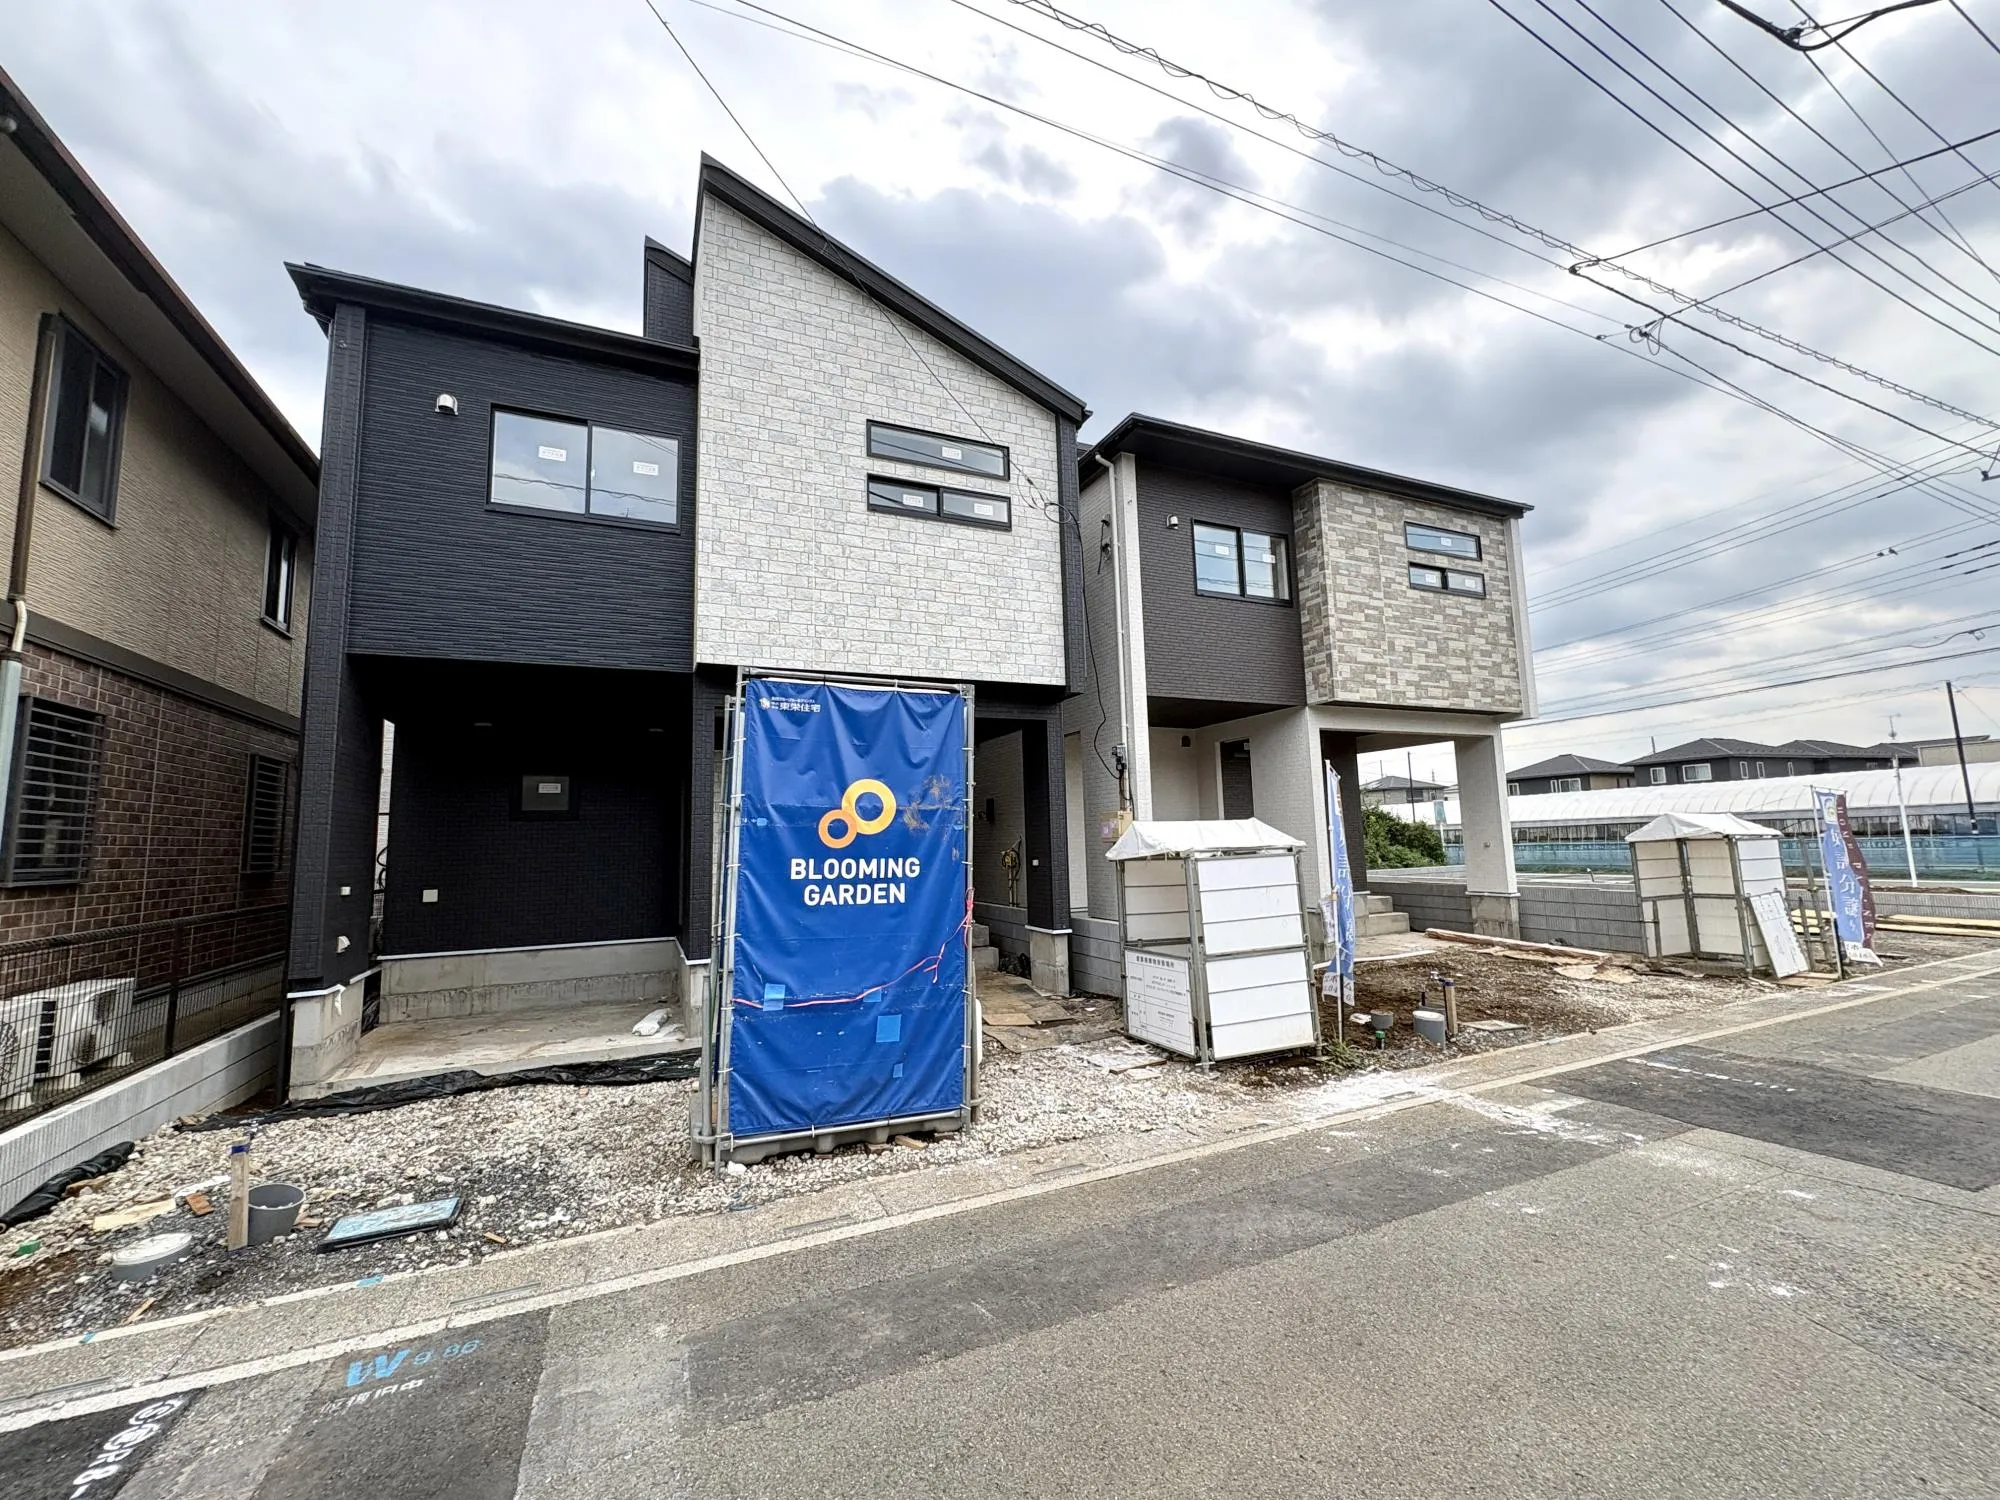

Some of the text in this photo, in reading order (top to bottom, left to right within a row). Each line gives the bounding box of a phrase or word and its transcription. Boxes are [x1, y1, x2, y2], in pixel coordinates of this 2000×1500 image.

[779, 702, 821, 713] 東栄住宅
[790, 856, 921, 880] BLOOMING
[803, 882, 906, 906] GARDEN
